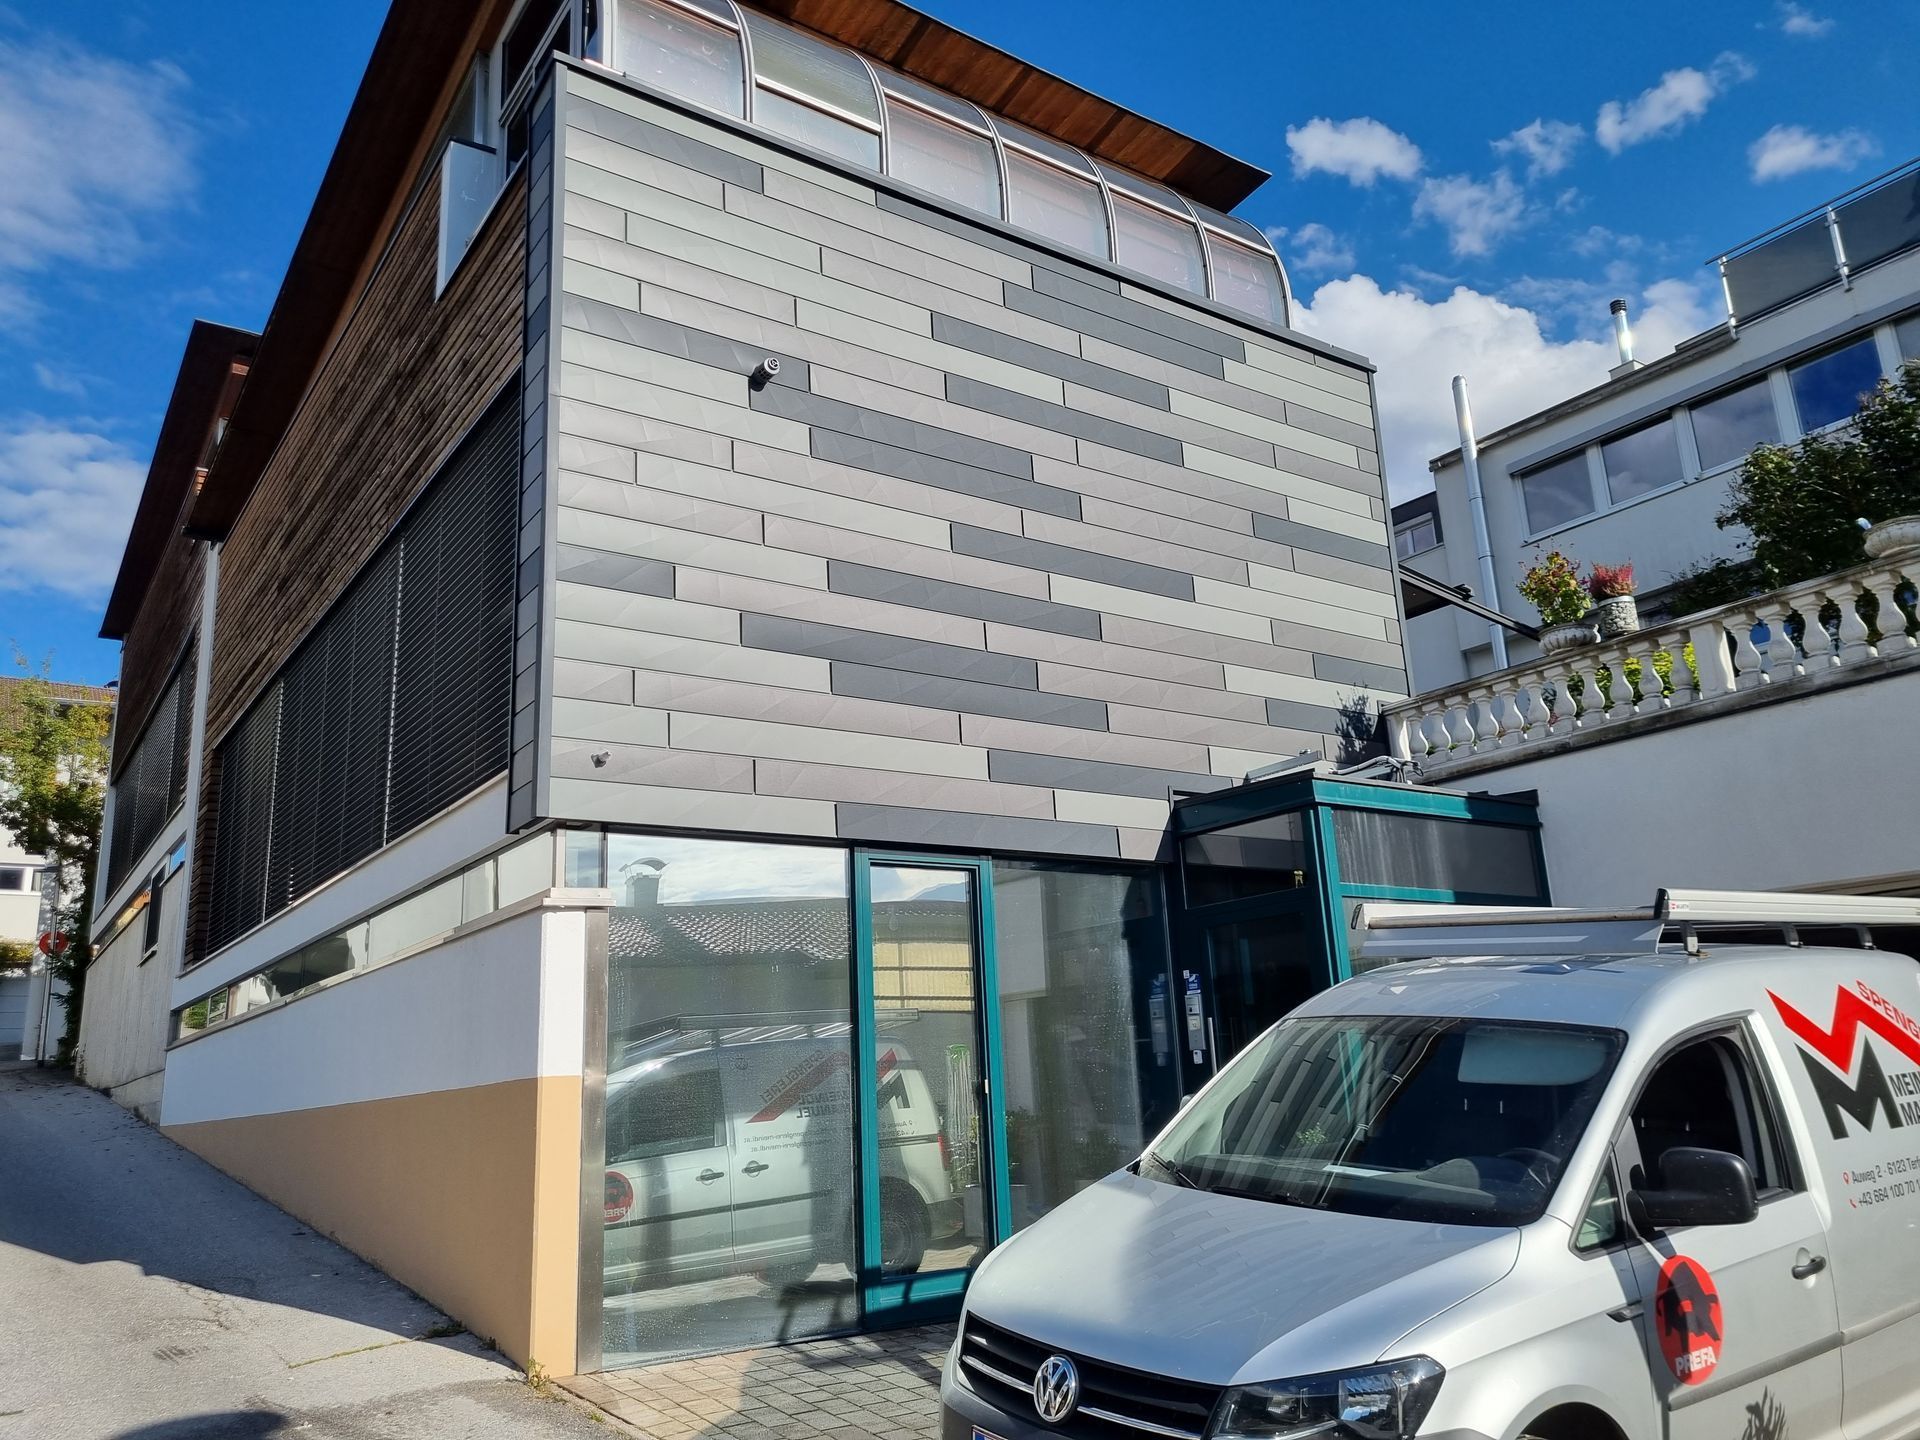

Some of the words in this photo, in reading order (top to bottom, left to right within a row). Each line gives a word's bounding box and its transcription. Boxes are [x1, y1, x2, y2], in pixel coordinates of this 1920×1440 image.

[1856, 979, 1920, 1040] SPENG
[1851, 1170, 1876, 1184] Auweg
[1875, 1165, 1882, 1178] 2
[1887, 1159, 1907, 1175] 6123
[1858, 1191, 1873, 1206] +43
[1873, 1186, 1889, 1203] 664
[1890, 1182, 1905, 1198] 100
[1904, 1180, 1916, 1194] 70
[1675, 1346, 1717, 1377] PREFA
